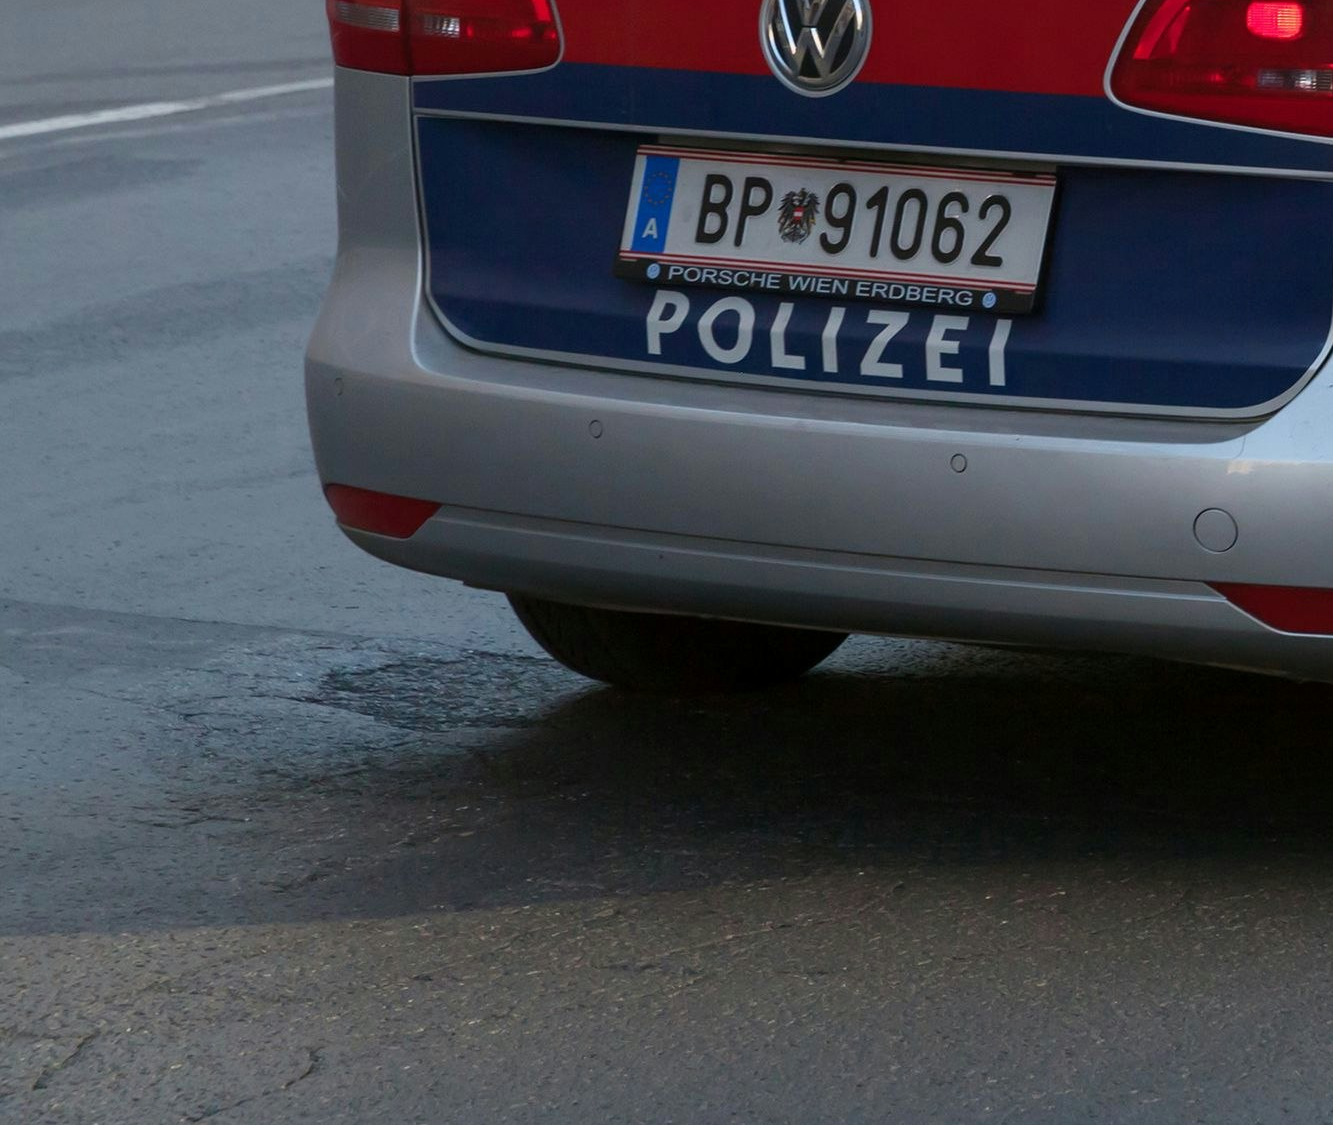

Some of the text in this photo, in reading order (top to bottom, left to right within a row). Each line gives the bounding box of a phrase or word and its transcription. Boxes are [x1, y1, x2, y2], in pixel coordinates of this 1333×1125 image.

[641, 217, 659, 239] A
[694, 173, 1012, 267] BP 91062
[667, 265, 974, 307] PORSCHE WIEN ERDBERG
[645, 288, 1013, 387] POLIZEI
